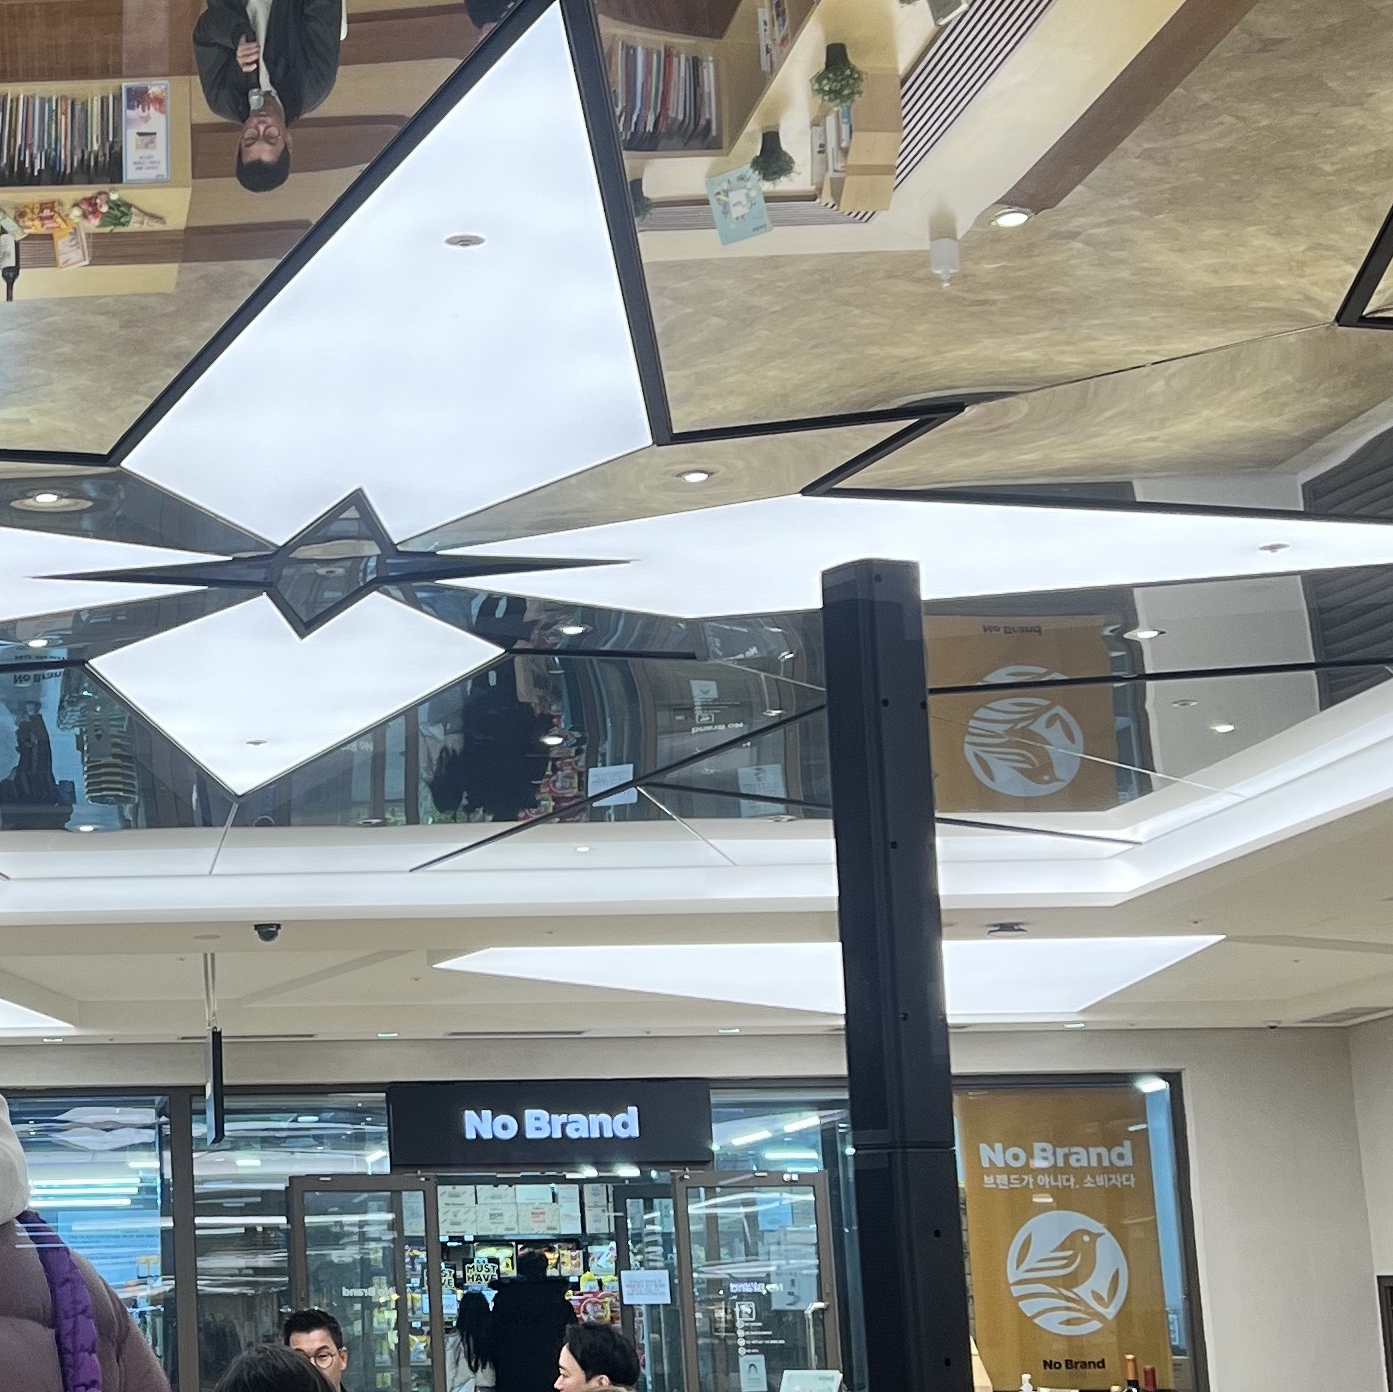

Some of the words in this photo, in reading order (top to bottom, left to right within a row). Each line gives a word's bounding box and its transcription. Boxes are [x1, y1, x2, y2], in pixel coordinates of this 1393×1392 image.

[463, 1108, 520, 1141] No
[523, 1105, 641, 1141] Brand
[979, 1142, 1026, 1169] No
[1032, 1140, 1134, 1169] Brand
[983, 1173, 1034, 1190] 브랜드가
[1037, 1173, 1080, 1189] 아니다.
[1083, 1173, 1136, 1189] 소비자다
[466, 1263, 499, 1274] MUST
[467, 1273, 498, 1284] HAVE
[1042, 1359, 1062, 1371] No
[1064, 1358, 1106, 1371] Brand
